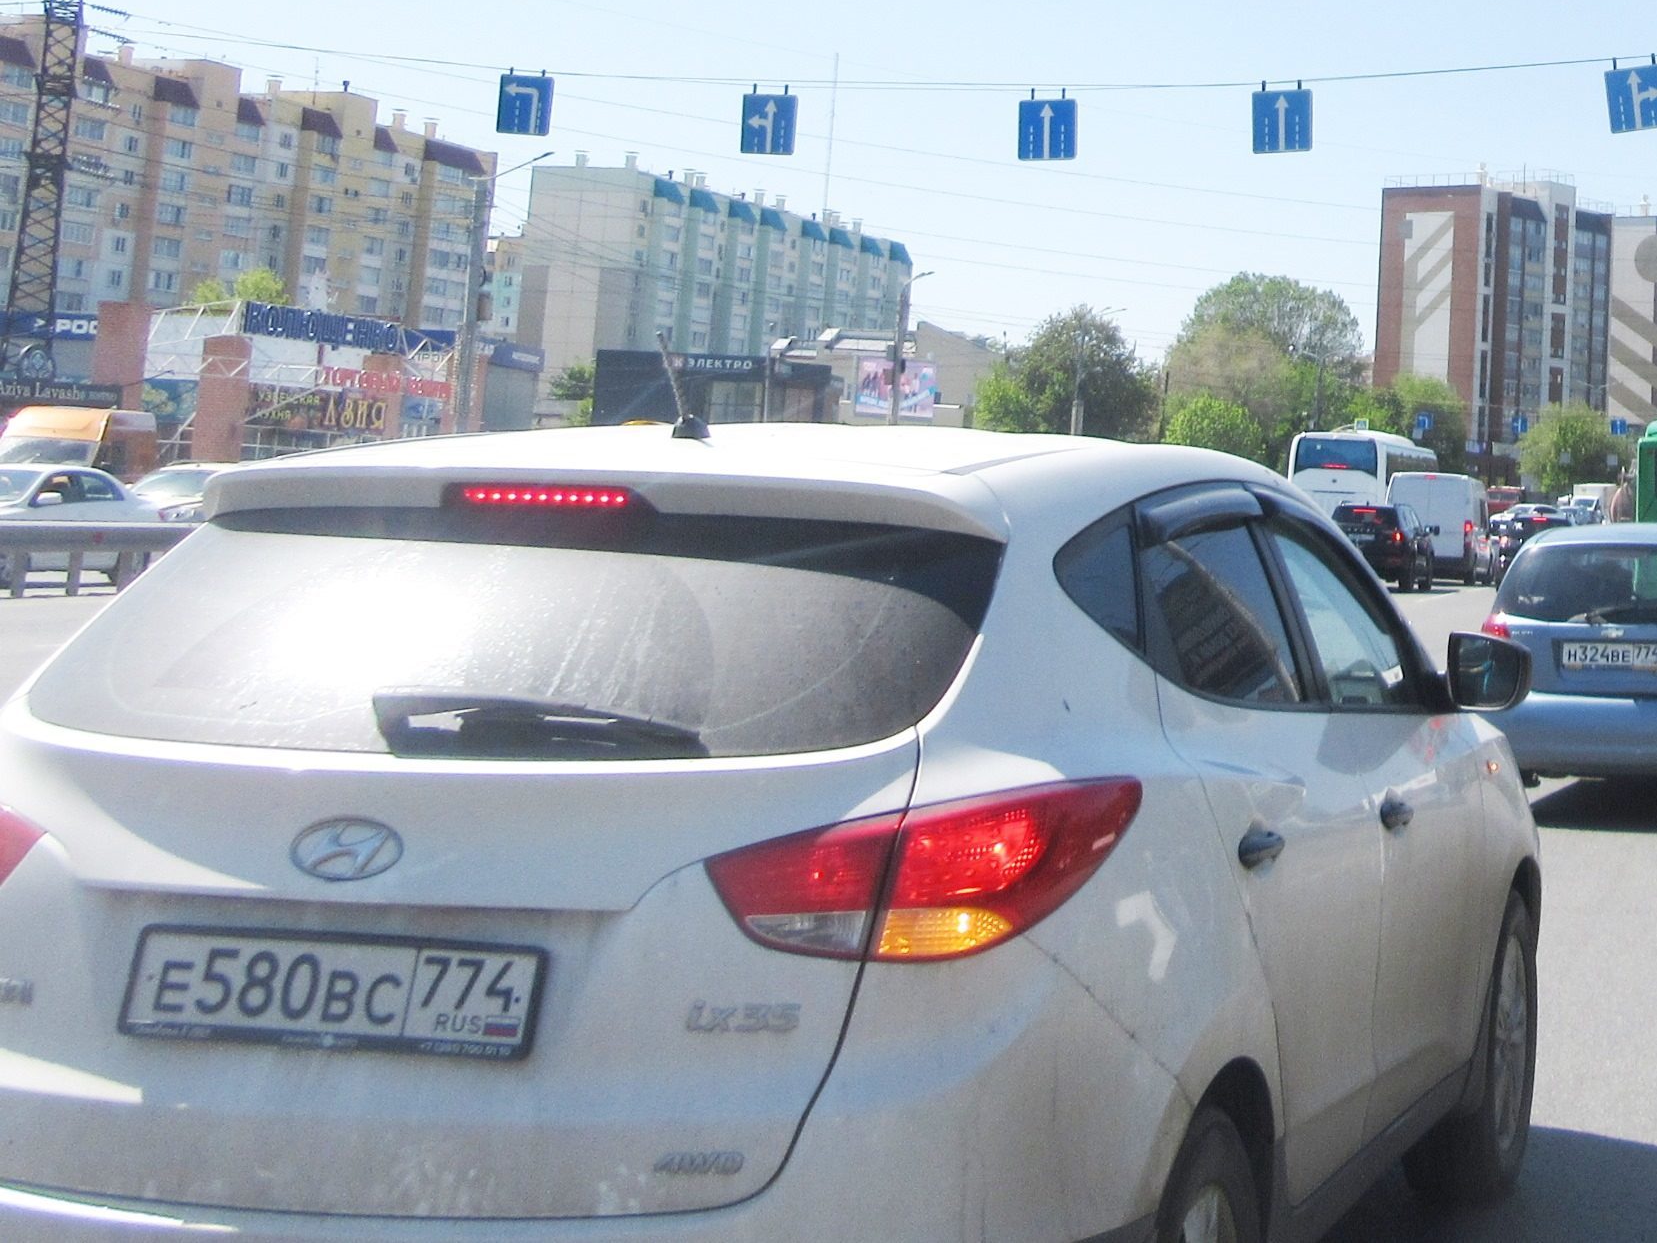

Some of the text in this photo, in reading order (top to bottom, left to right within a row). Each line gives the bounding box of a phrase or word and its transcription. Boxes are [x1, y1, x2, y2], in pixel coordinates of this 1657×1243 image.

[687, 357, 753, 370] ЭЛЕКТРО
[1567, 644, 1632, 664] Н324ВЕ
[152, 947, 516, 1026] Е580ВС 774
[433, 1013, 482, 1035] RUS
